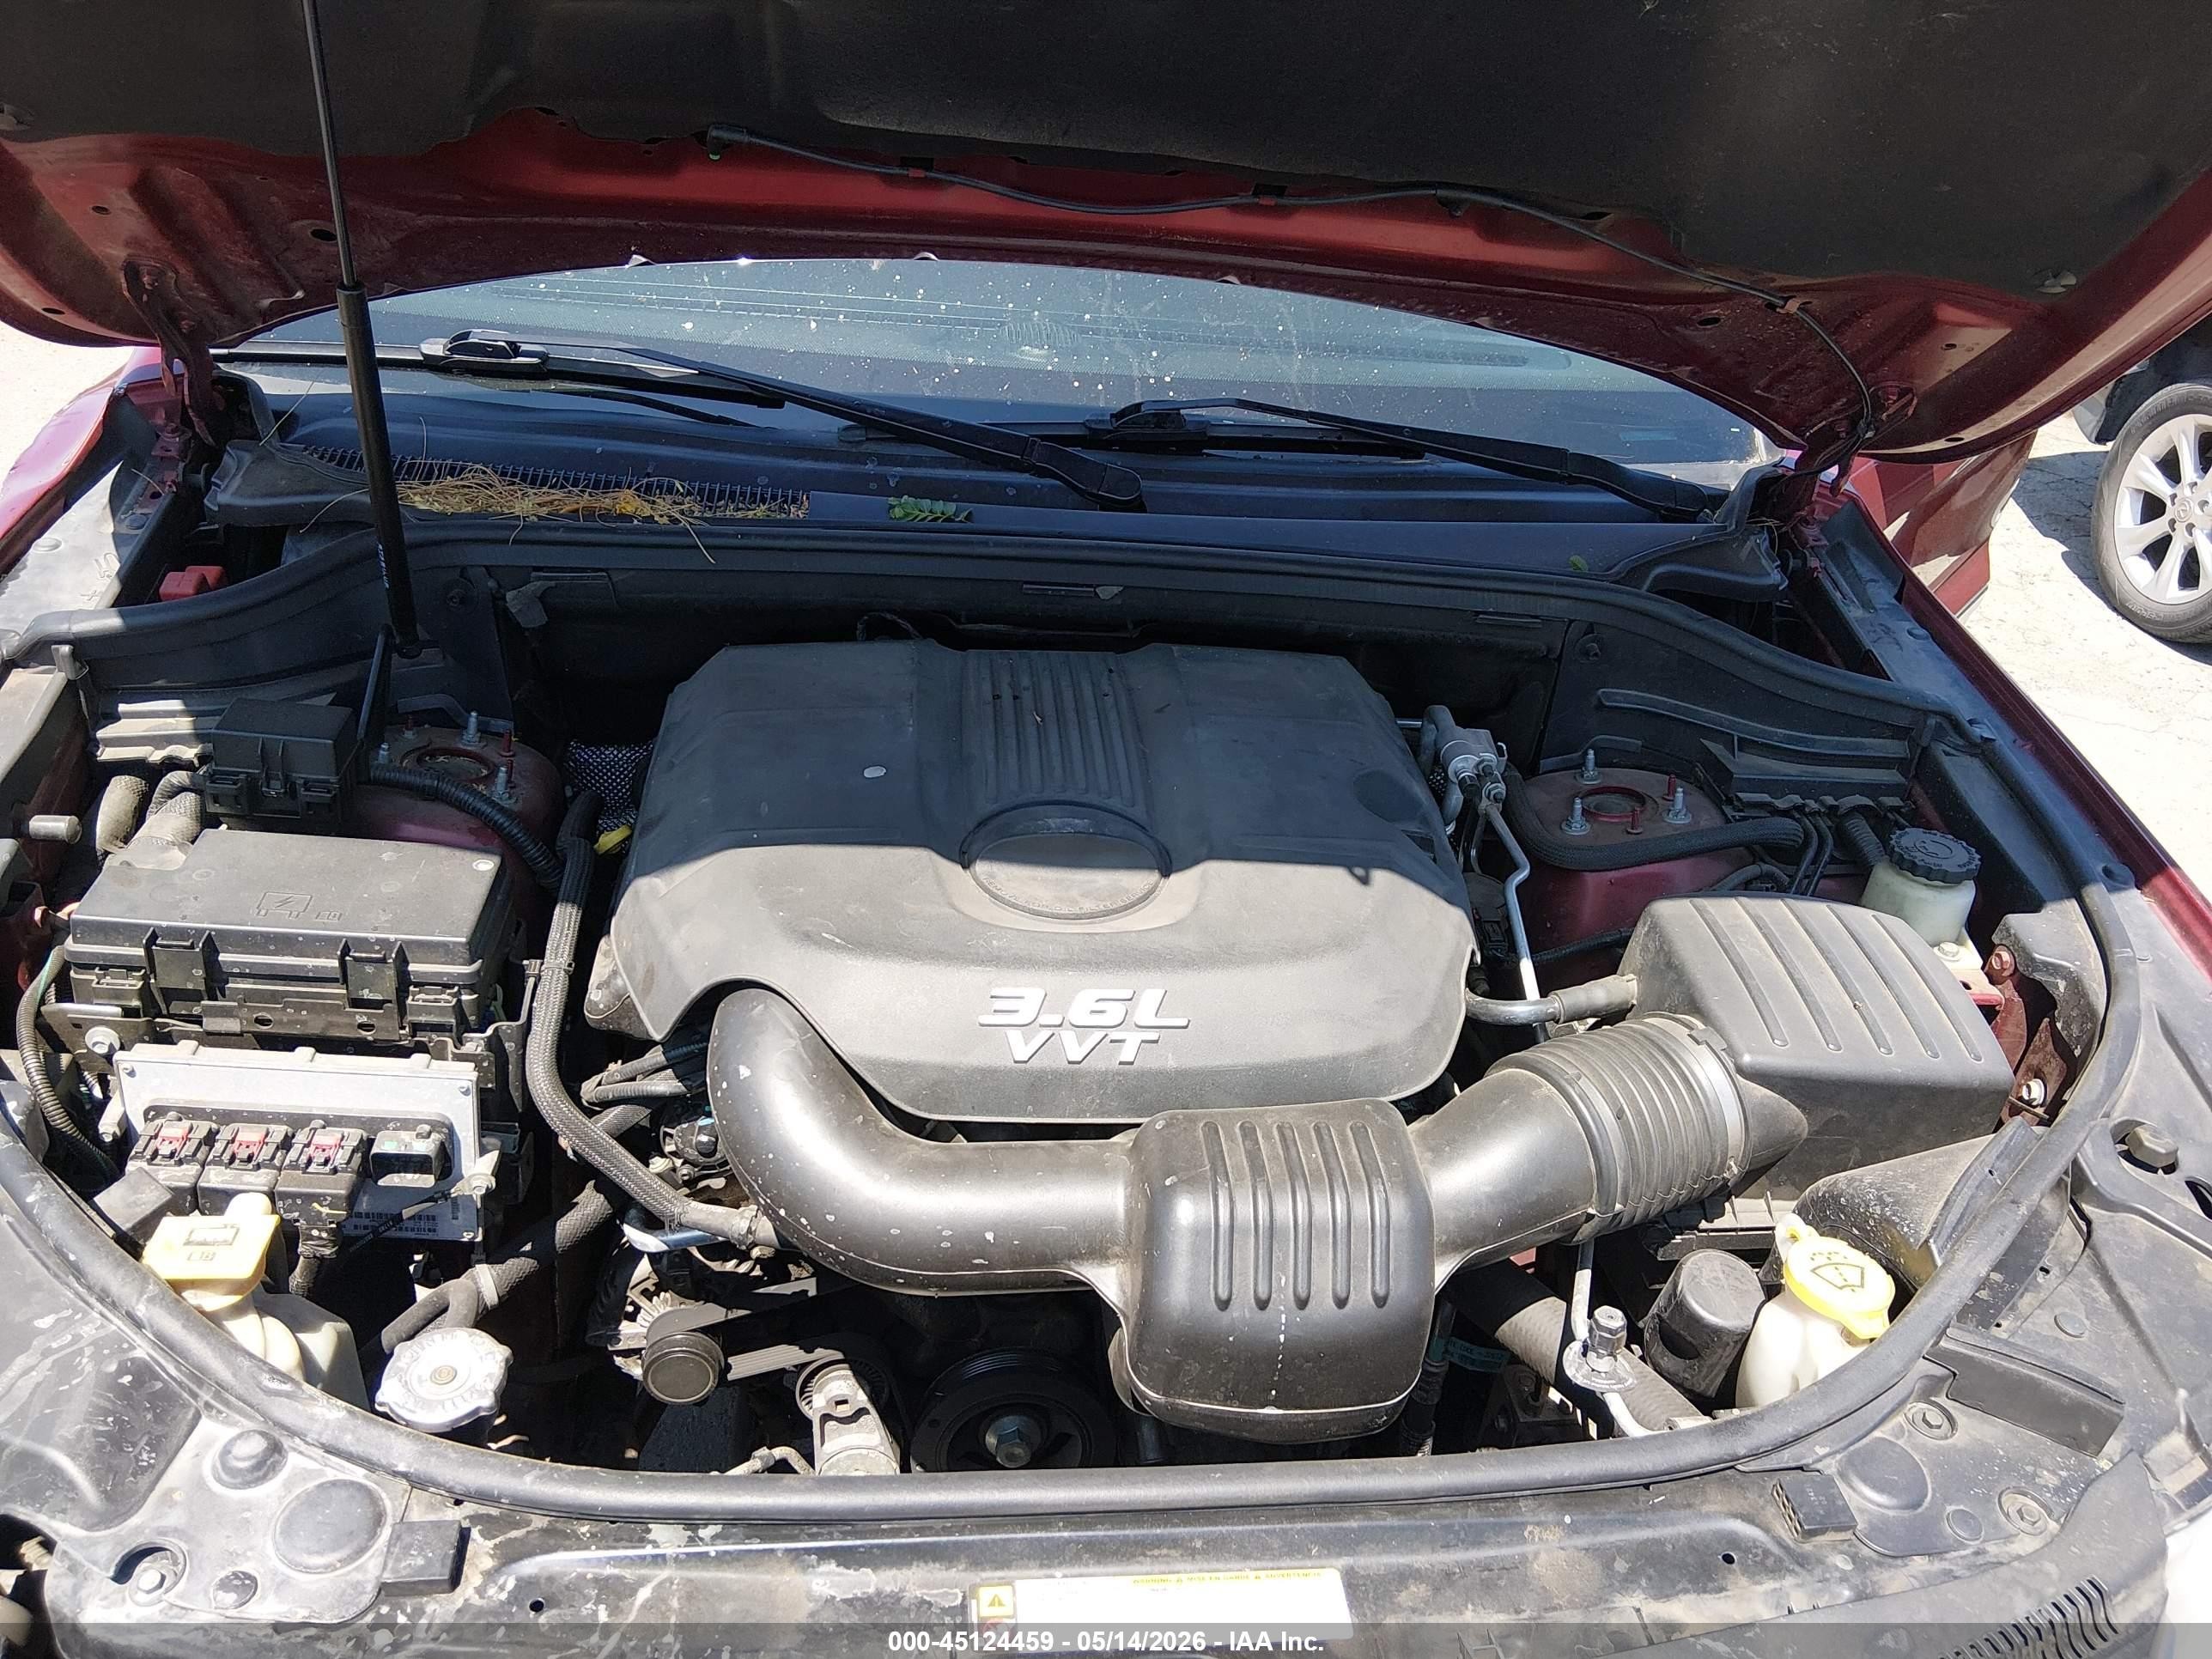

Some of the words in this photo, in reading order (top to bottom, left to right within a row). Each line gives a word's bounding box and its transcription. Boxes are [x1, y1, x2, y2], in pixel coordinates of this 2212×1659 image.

[1078, 901, 1115, 914] FILTER
[1115, 878, 1155, 907] SERVICE
[978, 988, 1191, 1030] 3.6L
[1005, 1030, 1161, 1066] VVT
